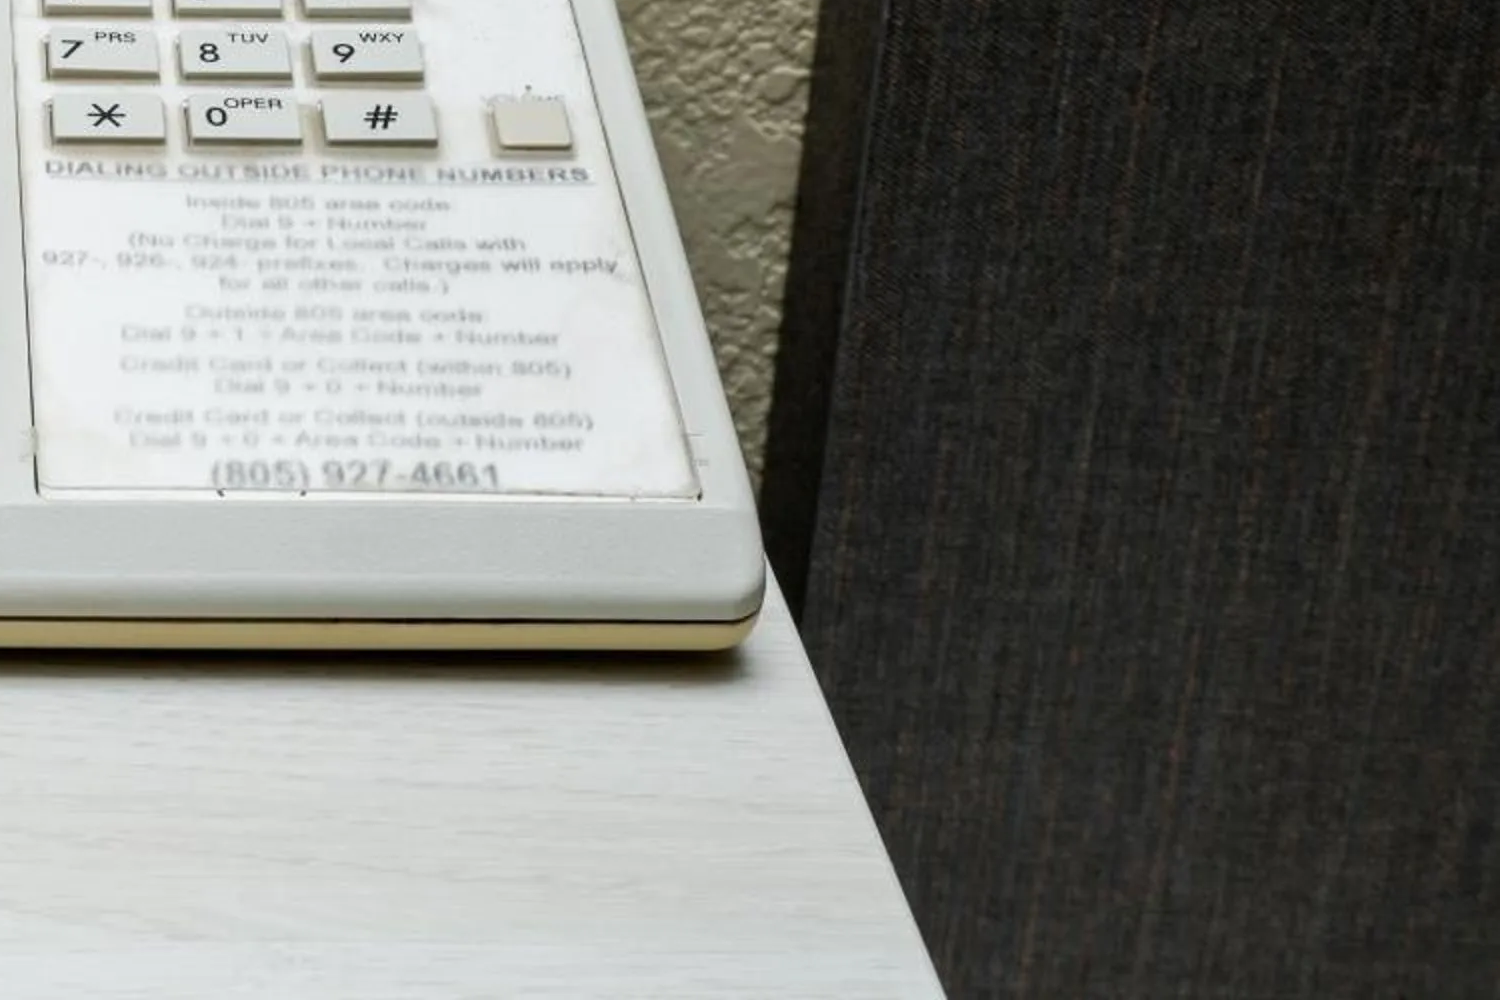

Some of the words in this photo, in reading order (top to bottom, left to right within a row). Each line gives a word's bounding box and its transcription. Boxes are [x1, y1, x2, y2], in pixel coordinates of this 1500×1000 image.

[61, 39, 84, 59] 7
[94, 31, 138, 43] PRS
[199, 43, 220, 63] 8
[228, 32, 269, 43] TUV
[332, 43, 356, 63] 9
[358, 32, 405, 43] WXY
[205, 106, 228, 126] 0
[224, 97, 283, 109] OPER
[363, 104, 399, 130] #
[45, 160, 168, 179] DIALING
[179, 163, 311, 181] OUTSIDE
[320, 164, 422, 182] PHONE
[437, 166, 590, 184] NUMBERS
[185, 194, 262, 210] Inside
[325, 200, 381, 211] area
[221, 215, 270, 230] Dial
[327, 217, 427, 231] Number
[183, 233, 277, 252] Charge
[285, 235, 316, 250] for
[326, 236, 396, 250] Local
[403, 237, 467, 251] Calls
[475, 236, 526, 251] with
[382, 257, 492, 276] Charges
[500, 257, 541, 273] will
[549, 257, 619, 276] apply
[219, 276, 250, 291] for
[262, 277, 289, 291] all
[298, 277, 361, 292] other
[185, 303, 287, 320] Outside
[353, 309, 412, 322] area
[121, 325, 172, 342] Dial
[280, 327, 342, 344] Area
[350, 328, 422, 345] Code
[455, 330, 561, 347] Number
[376, 379, 483, 398] Number
[211, 457, 311, 488] (805)
[321, 458, 499, 488] 927-4661
